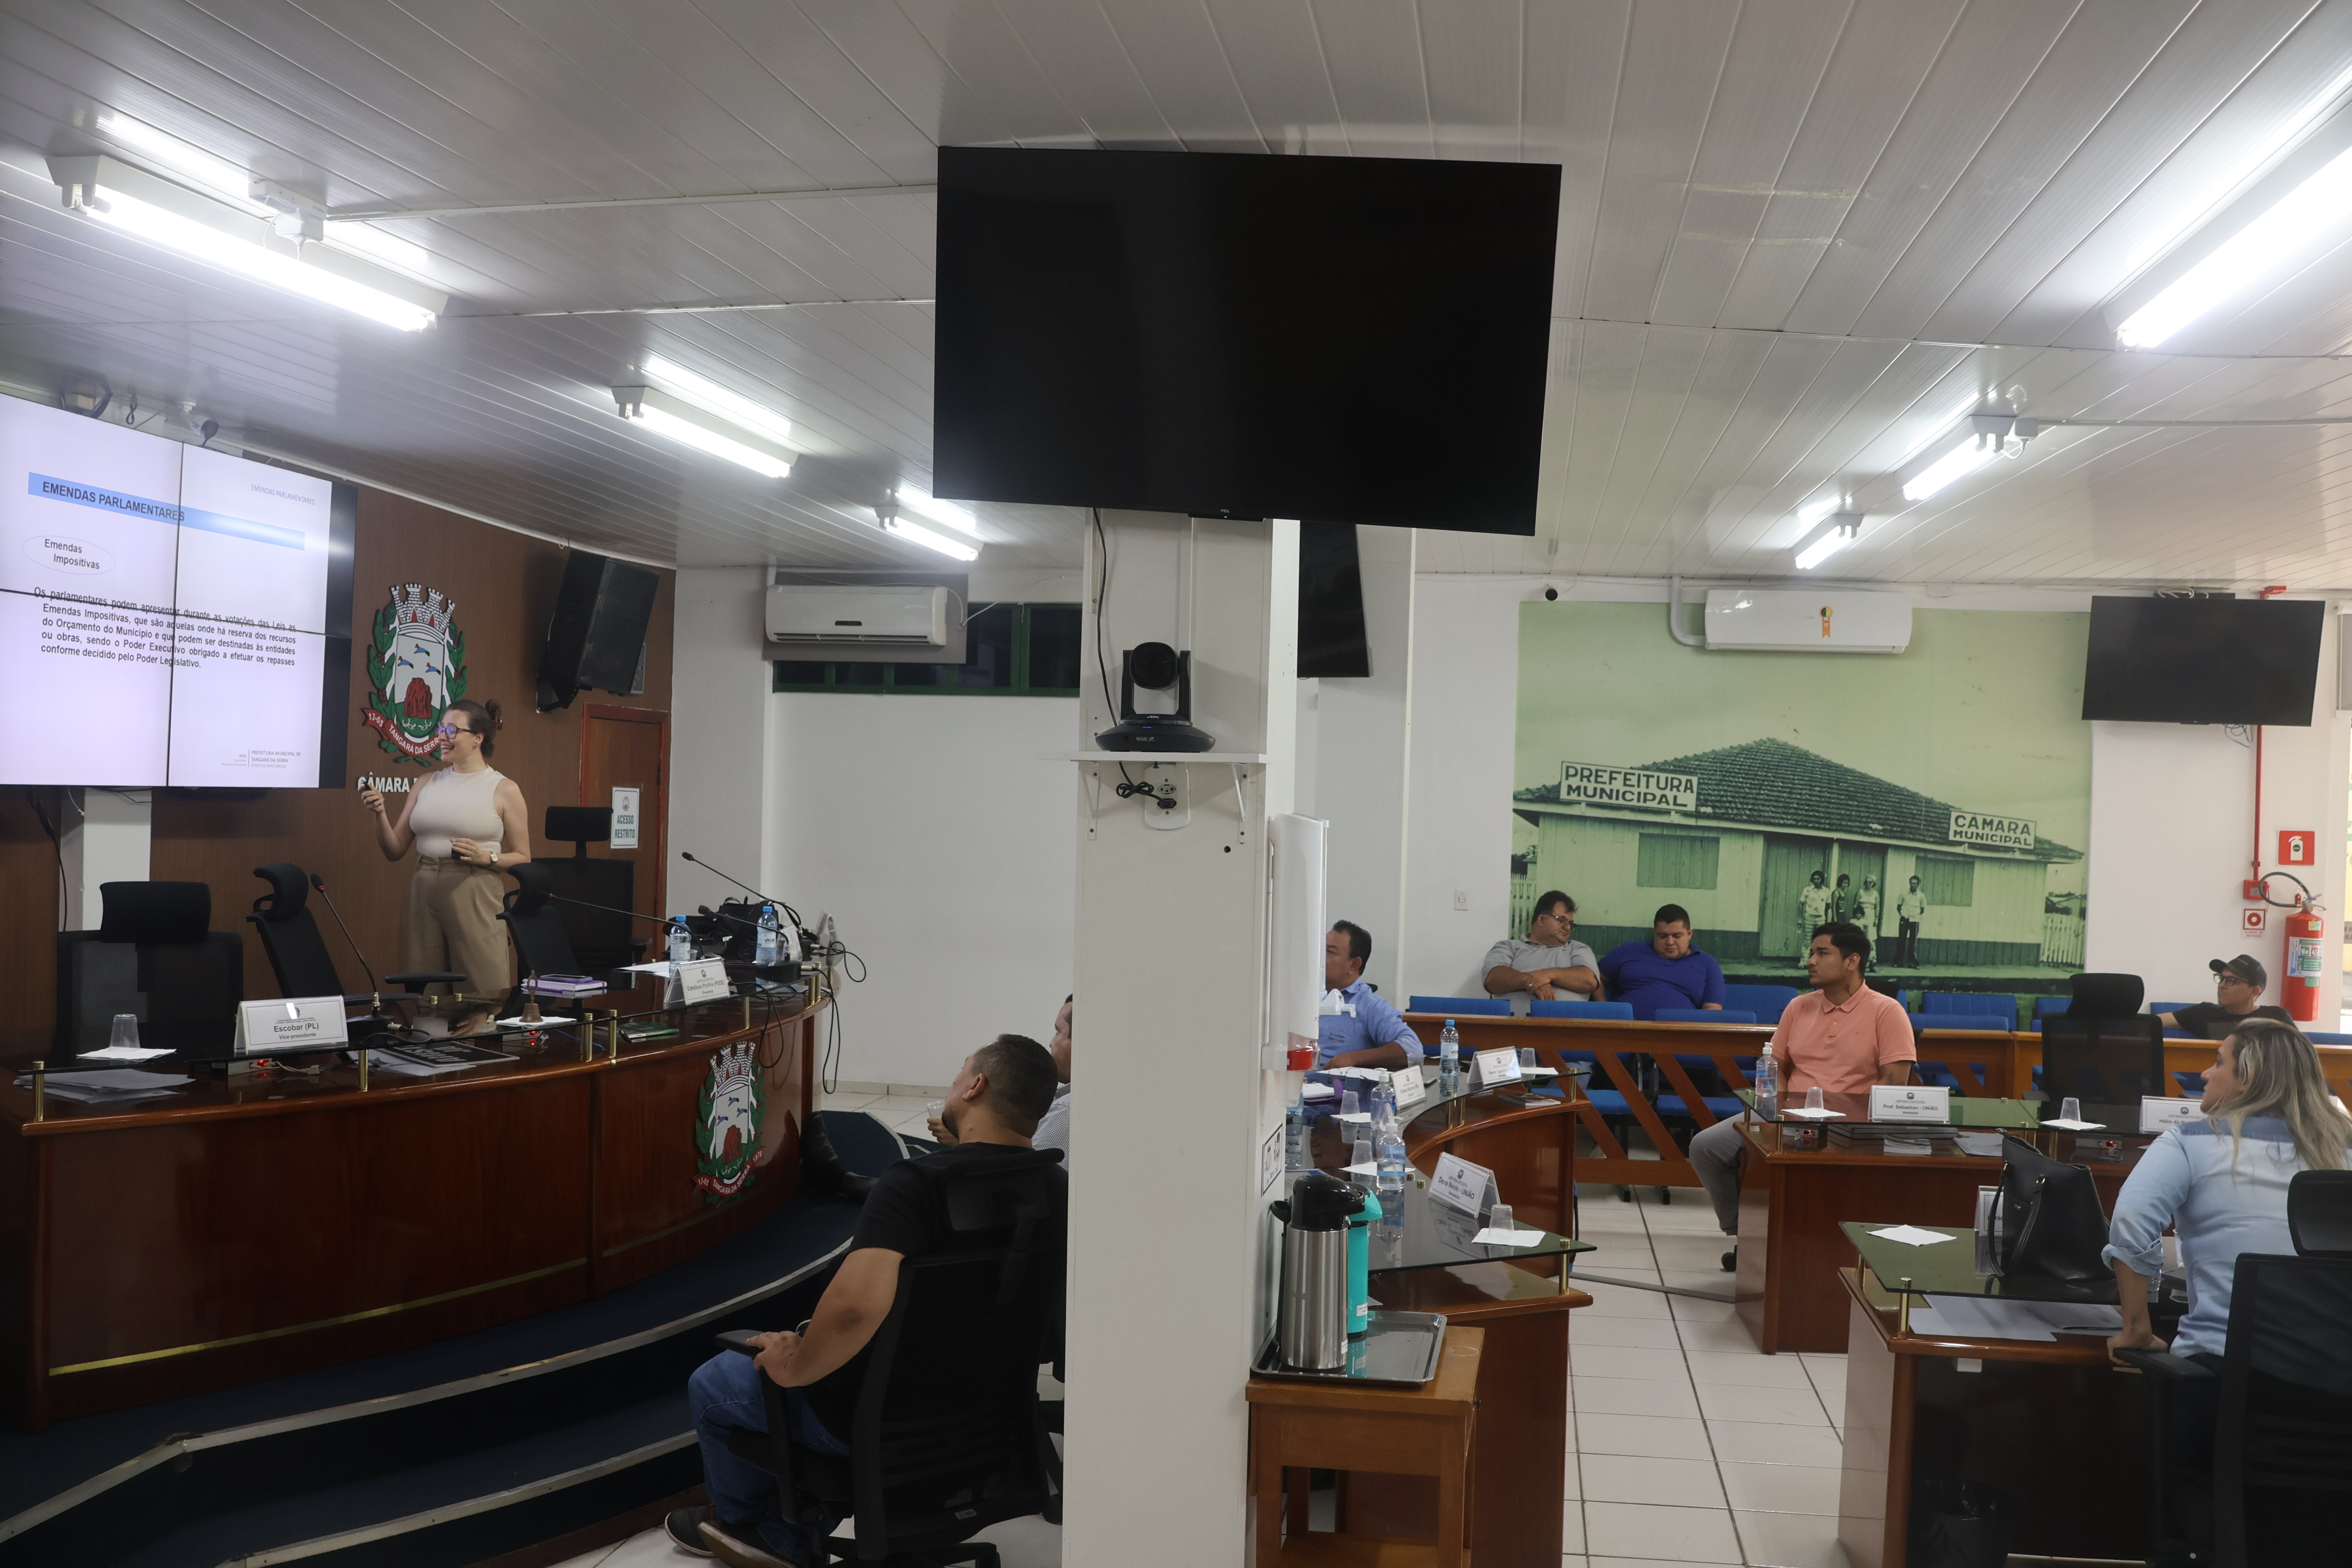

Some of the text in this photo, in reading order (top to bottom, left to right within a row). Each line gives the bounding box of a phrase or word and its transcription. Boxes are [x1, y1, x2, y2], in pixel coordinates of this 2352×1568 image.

[43, 481, 185, 521] EMENDAS PARLAMENTARES
[251, 484, 315, 505] EMENDAS PARLAMENTARES
[45, 539, 82, 554] Emendas
[54, 554, 100, 569] Impositivas
[34, 587, 45, 597] Os
[50, 590, 107, 606] parlamentares
[111, 600, 137, 610] podem
[184, 608, 210, 621] durante
[225, 615, 254, 627] votações
[258, 619, 269, 629] das
[272, 621, 285, 631] Leis
[289, 624, 296, 632] as
[43, 603, 296, 644] Emendas Impositivas, que são aquelas onde há reserva dos recursos
[42, 617, 53, 626] do
[56, 619, 100, 632] Orçamento
[103, 625, 113, 633] do
[116, 626, 152, 639] Município
[162, 633, 175, 642] que
[178, 635, 202, 644] podem
[218, 639, 254, 650] destinadas
[256, 643, 263, 651] às
[265, 645, 296, 655] entidades
[41, 645, 201, 668] conforme decidido pelo Poder Legislativo.
[57, 632, 82, 644] obras,
[86, 637, 111, 646] sendo
[123, 639, 145, 650] Poder
[189, 648, 220, 658] obrigado
[230, 652, 253, 661] efetuar
[267, 657, 295, 666] repasses
[368, 713, 384, 727] 13-05
[389, 724, 414, 753] TANGARÁ
[424, 737, 439, 753] SERR
[1565, 765, 1694, 793] PREFEITURA
[1567, 784, 1688, 807] MUNICIPAL
[617, 815, 633, 824] ACESSO
[614, 829, 635, 838] RESTRITO
[1953, 830, 2031, 846] MUNICIPAL
[305, 1022, 319, 1031] (PL)
[713, 1179, 731, 1194] TANGARÁ
[737, 1165, 750, 1187] SERRA
[1439, 1176, 1448, 1186] Dona
[1448, 1181, 1459, 1192] Neide
[1461, 1188, 1475, 1200] UNIÃO
